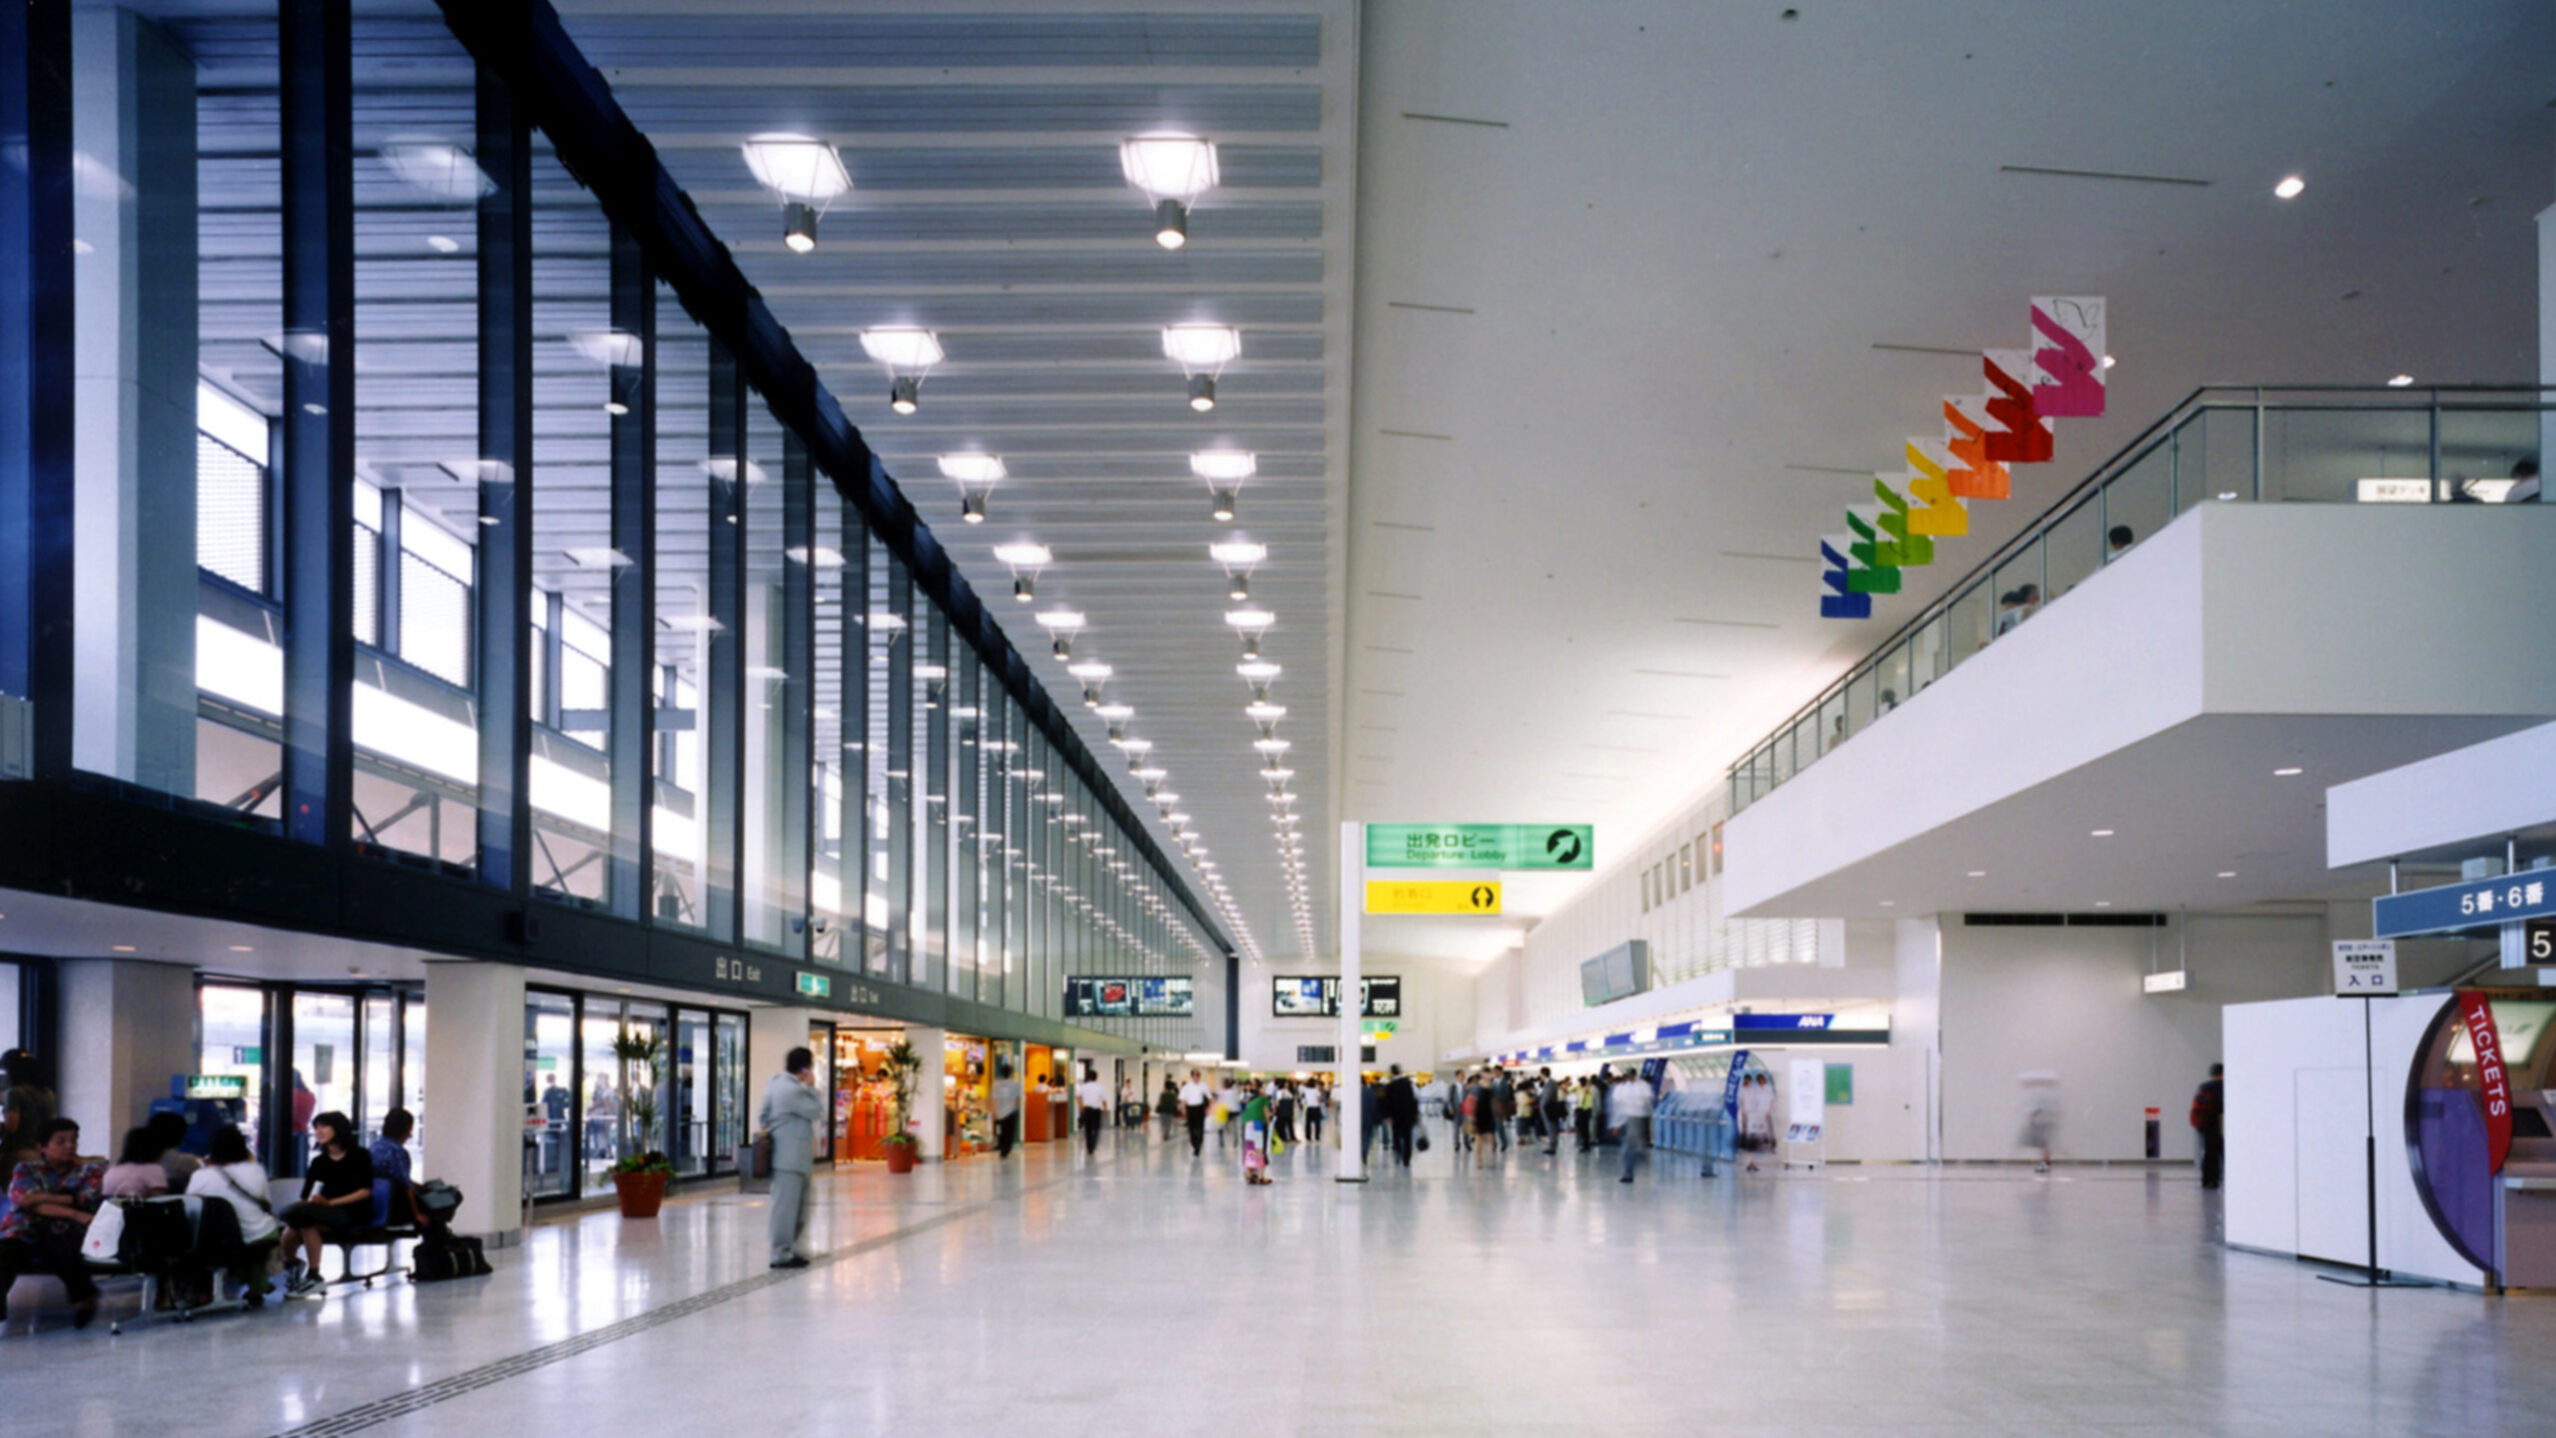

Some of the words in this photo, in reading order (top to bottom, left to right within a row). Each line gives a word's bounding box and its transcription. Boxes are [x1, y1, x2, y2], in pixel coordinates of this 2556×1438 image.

[1406, 832, 1496, 848] 出発ロビー
[1406, 849, 1465, 861] Departure
[1470, 849, 1507, 861] Lobby
[2460, 881, 2544, 915] 5番・6番
[2532, 930, 2552, 959] 5
[716, 956, 743, 981] 出口
[747, 966, 761, 982] Exit
[1797, 1016, 1825, 1028] ANA
[2469, 1004, 2507, 1117] TICKETS
